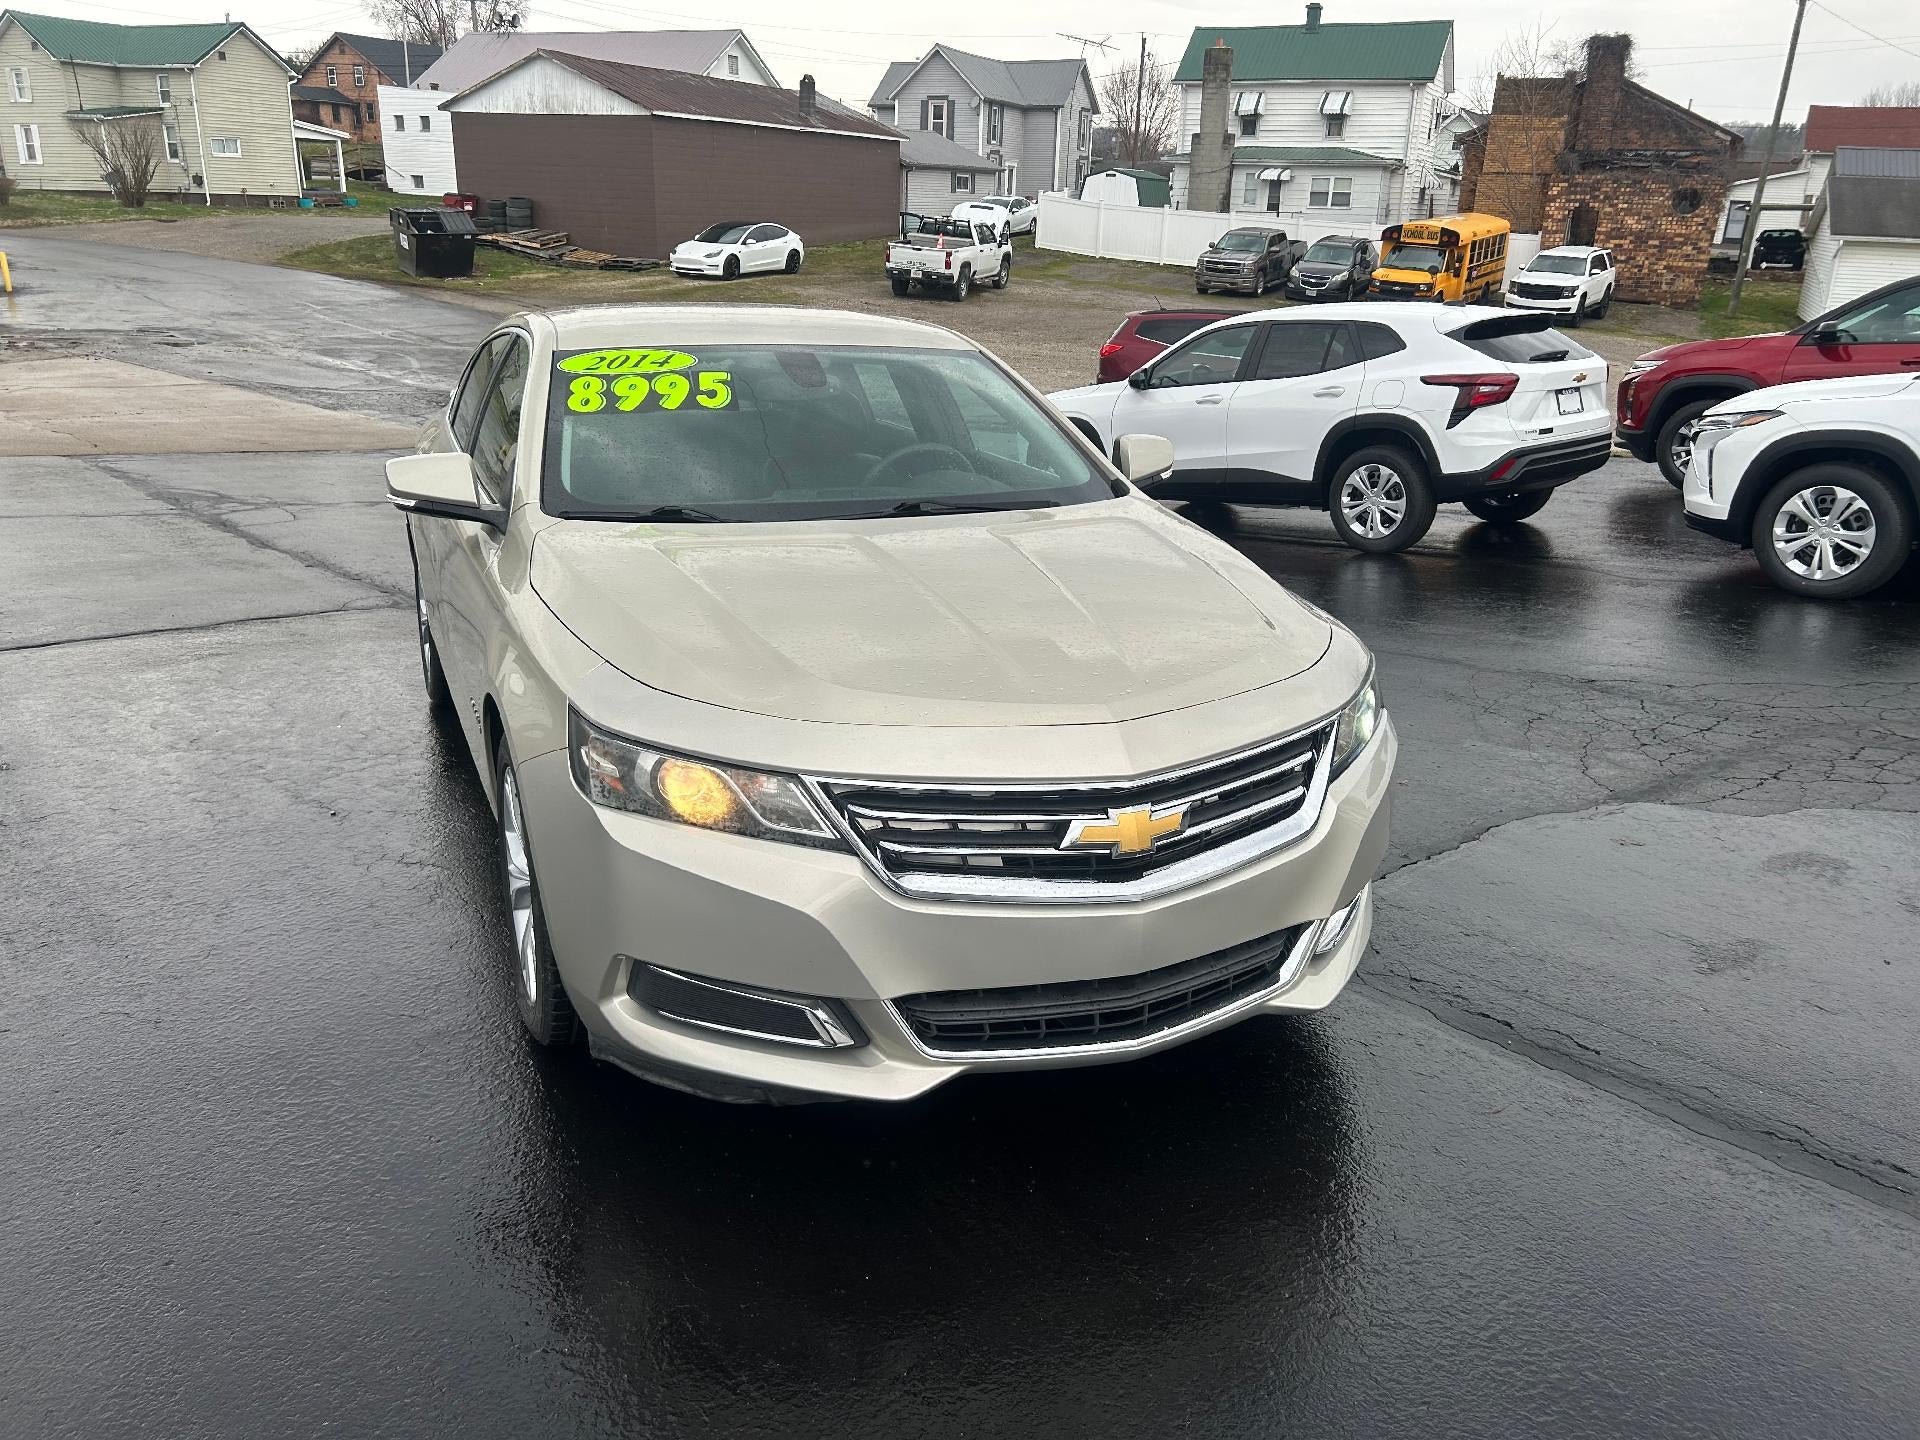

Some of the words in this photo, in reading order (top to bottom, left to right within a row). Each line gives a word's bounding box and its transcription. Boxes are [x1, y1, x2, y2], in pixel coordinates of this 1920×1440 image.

[1402, 229, 1425, 240] SCHOOL
[1426, 230, 1439, 241] BUS
[583, 353, 677, 371] 2014
[567, 371, 732, 413] 8995
